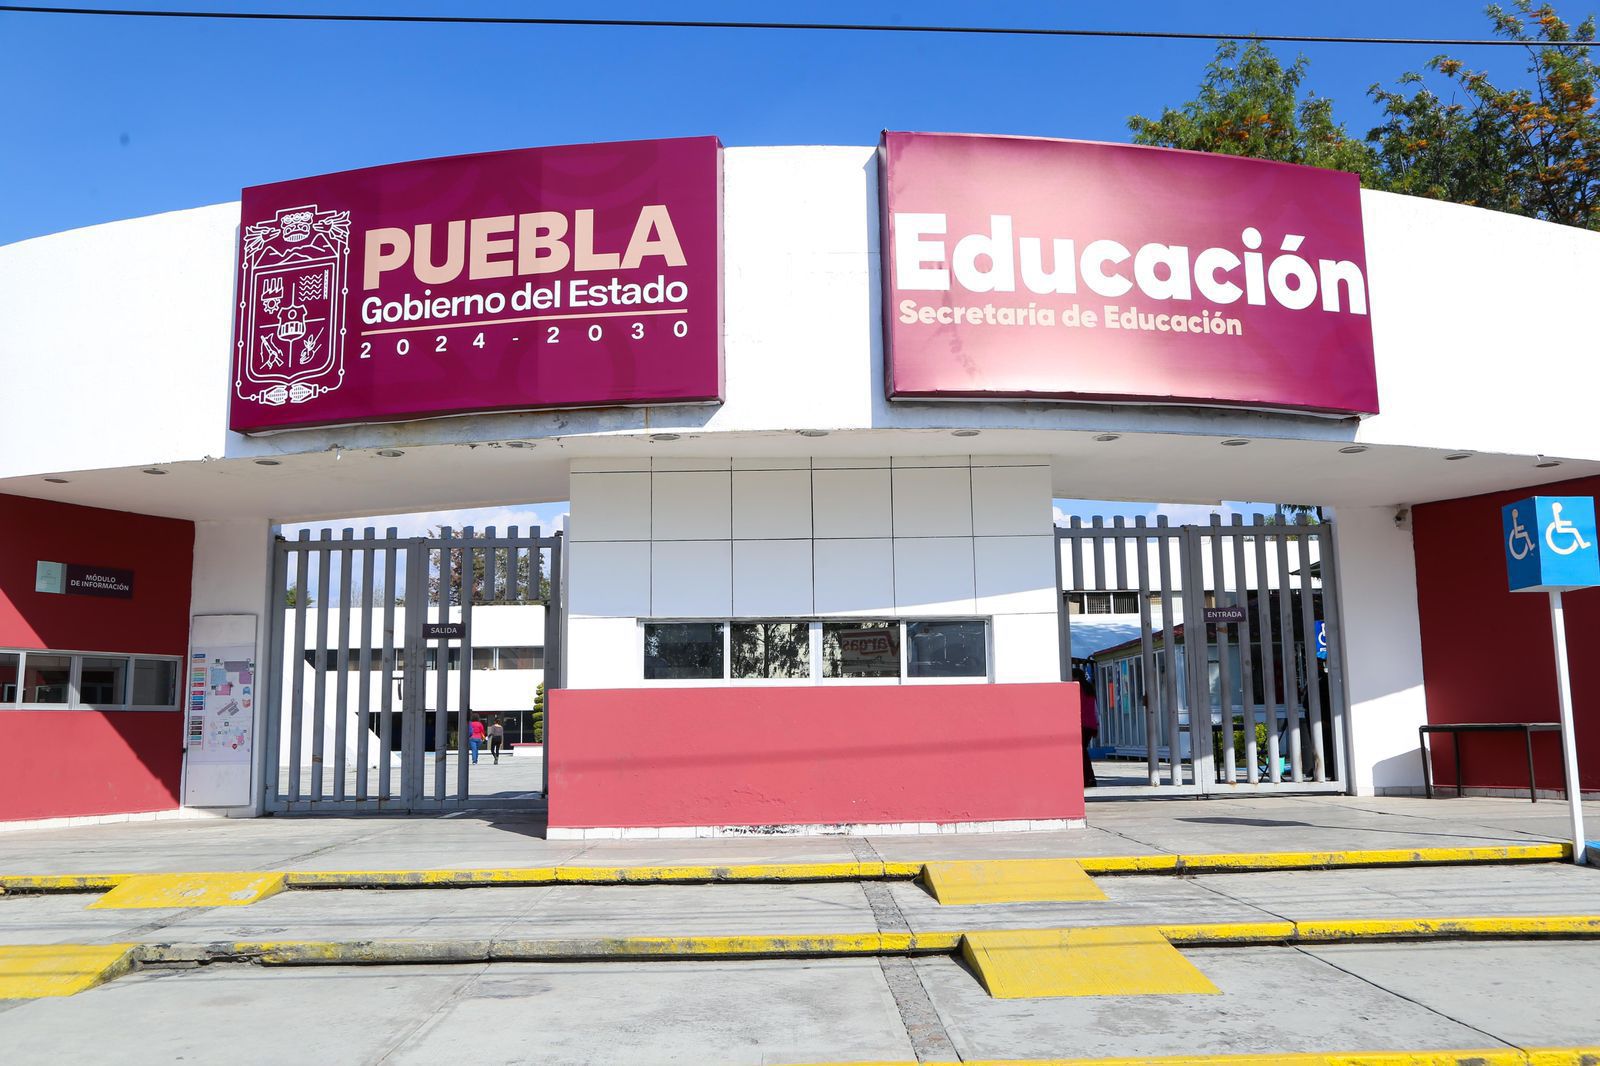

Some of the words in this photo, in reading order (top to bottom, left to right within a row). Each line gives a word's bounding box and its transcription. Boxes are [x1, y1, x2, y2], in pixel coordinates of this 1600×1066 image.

[363, 204, 688, 290] PUEBLA
[895, 213, 1368, 316] Educación
[361, 289, 506, 325] Gobierno
[511, 281, 561, 312] del
[569, 275, 688, 307] Estado
[899, 299, 1055, 328] Secretaría
[1062, 304, 1098, 329] de
[1104, 305, 1243, 336] Educación
[81, 581, 129, 591] INFORMACIÓN
[86, 574, 116, 583] MÓDULO
